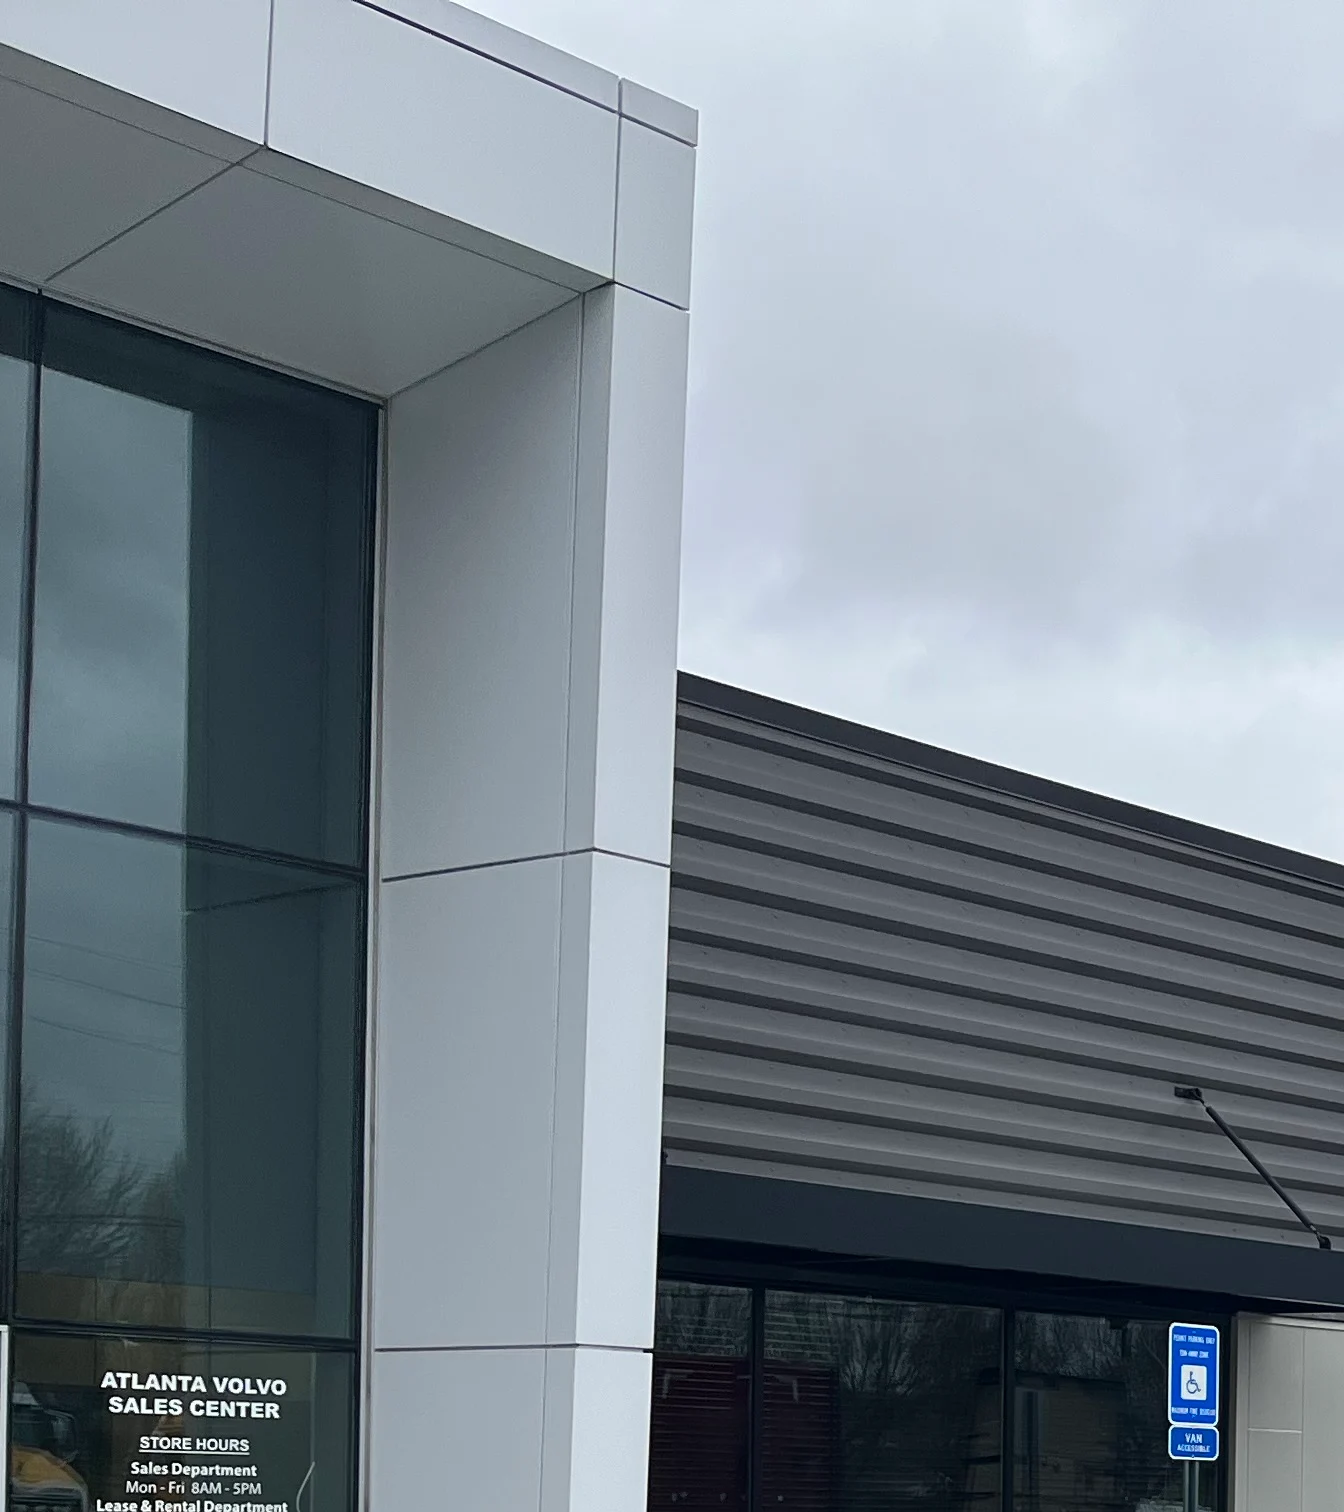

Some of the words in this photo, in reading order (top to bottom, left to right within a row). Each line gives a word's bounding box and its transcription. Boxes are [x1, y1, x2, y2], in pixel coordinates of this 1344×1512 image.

[100, 1371, 207, 1393] ATLANTA
[213, 1376, 287, 1396] VOLVO
[108, 1396, 183, 1415] SALES
[189, 1399, 281, 1419] CENTER
[139, 1436, 192, 1450] STORE
[196, 1438, 250, 1452] HOURS
[1184, 1433, 1203, 1444] VAN
[130, 1461, 168, 1475] Sales
[171, 1462, 258, 1478] Department
[125, 1480, 157, 1494] Mon
[168, 1480, 185, 1494] Fri
[190, 1482, 222, 1495] 8AM
[232, 1482, 262, 1495] 5PM
[96, 1499, 138, 1512] Lease
[140, 1499, 152, 1512] &
[154, 1499, 201, 1512] Rental
